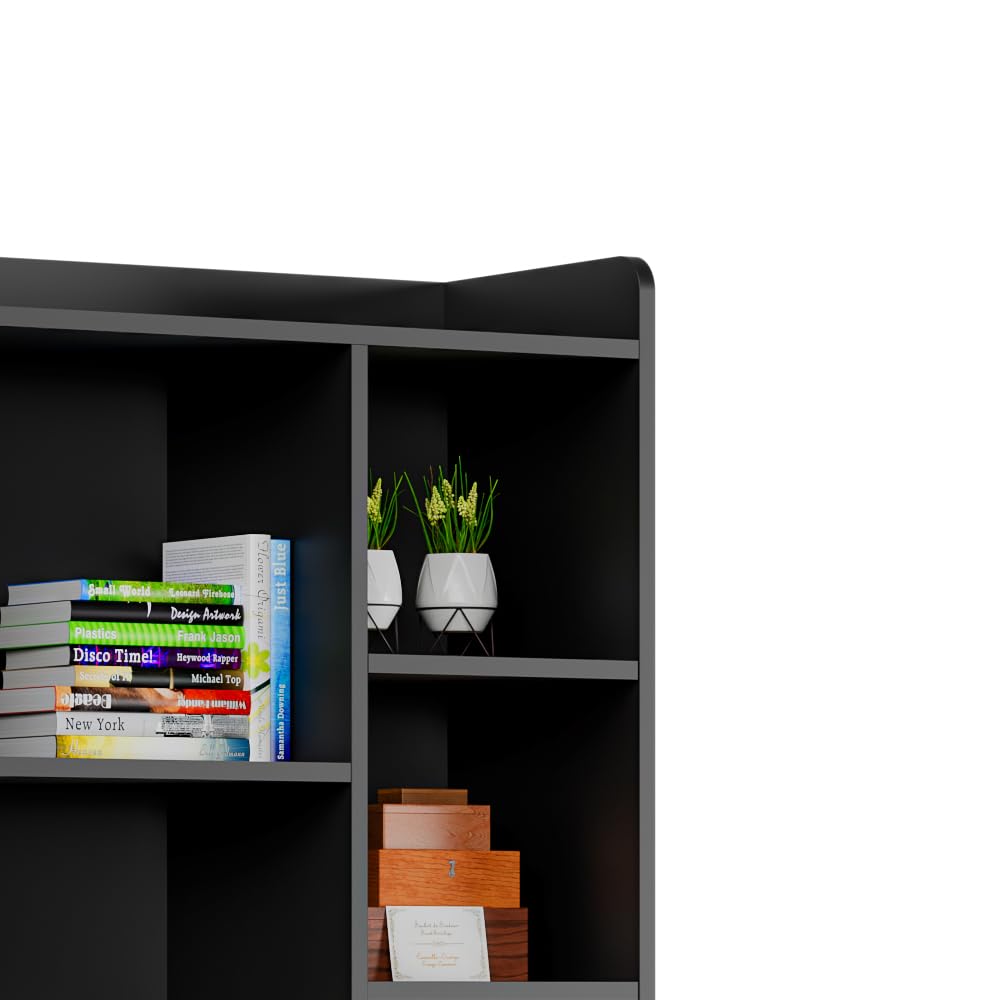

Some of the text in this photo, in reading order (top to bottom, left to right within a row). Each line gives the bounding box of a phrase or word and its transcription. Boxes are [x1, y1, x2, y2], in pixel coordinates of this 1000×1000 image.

[272, 543, 288, 610] Just Blue
[88, 583, 151, 597] Small World
[168, 587, 200, 598] Leonard
[170, 606, 242, 623] Design Artwork
[256, 590, 270, 640] Origami
[74, 627, 117, 640] Plastics
[177, 630, 241, 643] Frank Jason
[73, 648, 153, 664] Disco Time!
[176, 653, 239, 665] Heywood Rapper
[191, 673, 242, 686] Michael Top
[61, 693, 112, 709] Beagle
[212, 699, 247, 710] William
[65, 717, 125, 732] New York
[277, 684, 287, 760] Samantha Downing
